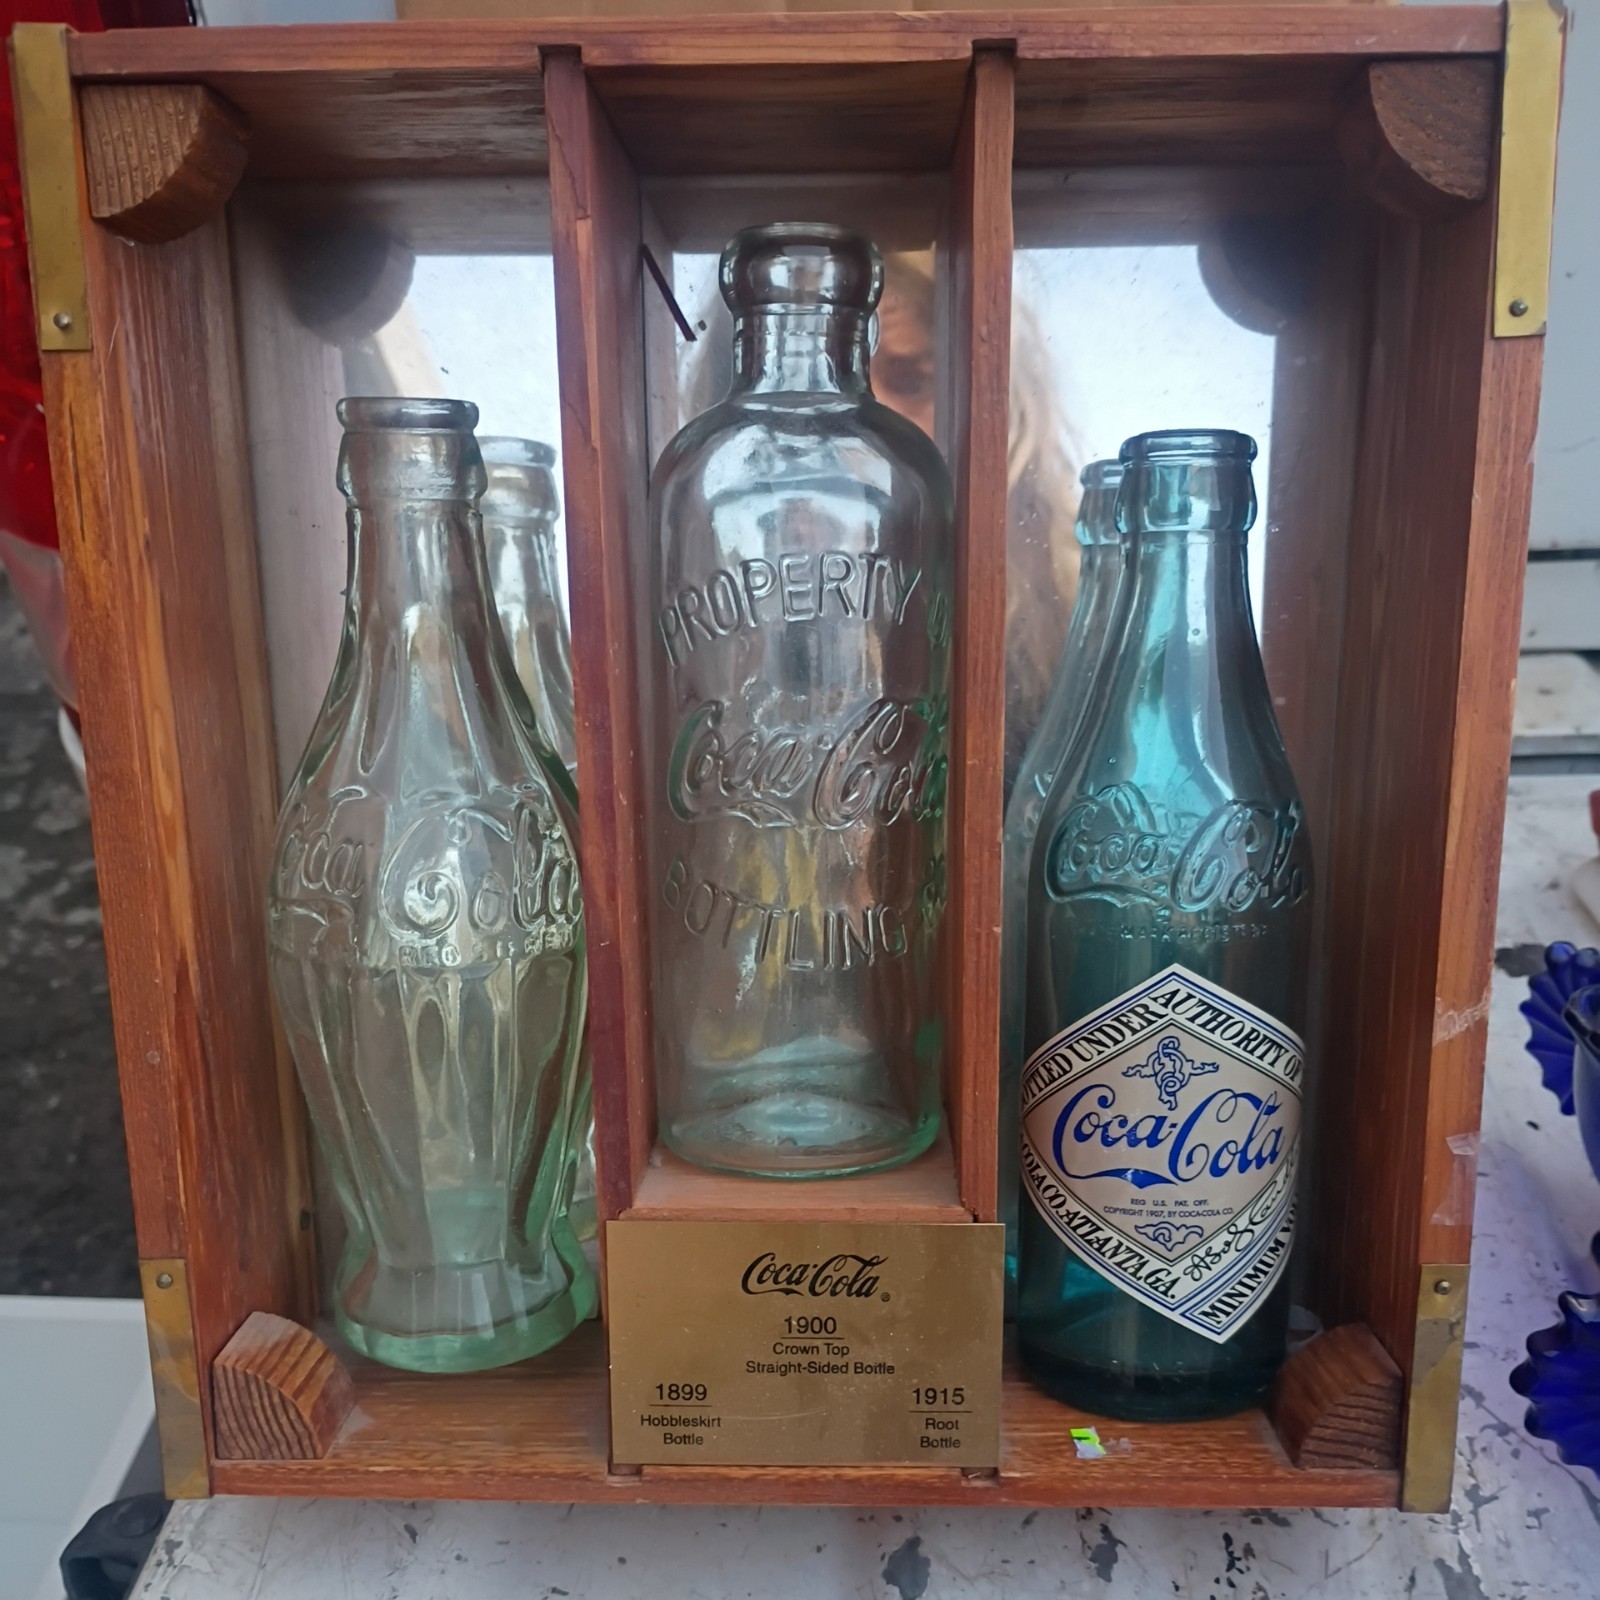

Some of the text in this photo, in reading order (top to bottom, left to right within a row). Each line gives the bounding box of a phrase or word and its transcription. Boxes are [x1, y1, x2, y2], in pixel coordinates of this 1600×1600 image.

[657, 551, 922, 668] PROPERTY
[663, 858, 910, 972] BOTTLING
[1064, 1003, 1169, 1062] UNDER
[1148, 988, 1290, 1069] AUTHORITY
[1052, 1084, 1283, 1189] Coca-Cola
[1103, 1205, 1235, 1219] COPYRIGHT 1907, BY COCA-COLA CO.
[1059, 1210, 1150, 1282] ATLANTA,
[1143, 1267, 1181, 1300] GA.
[1200, 1237, 1286, 1326] MINIMUM
[784, 1316, 838, 1335] 1900
[772, 1342, 850, 1357] Crown Top
[745, 1360, 895, 1376] Straight-Sided Bottle
[655, 1383, 708, 1401] 1899
[912, 1387, 965, 1406] 1915
[640, 1414, 722, 1428] Hobbleskirt
[925, 1417, 960, 1431] Root
[663, 1432, 704, 1446] Bottle
[920, 1435, 961, 1449] Bottle
